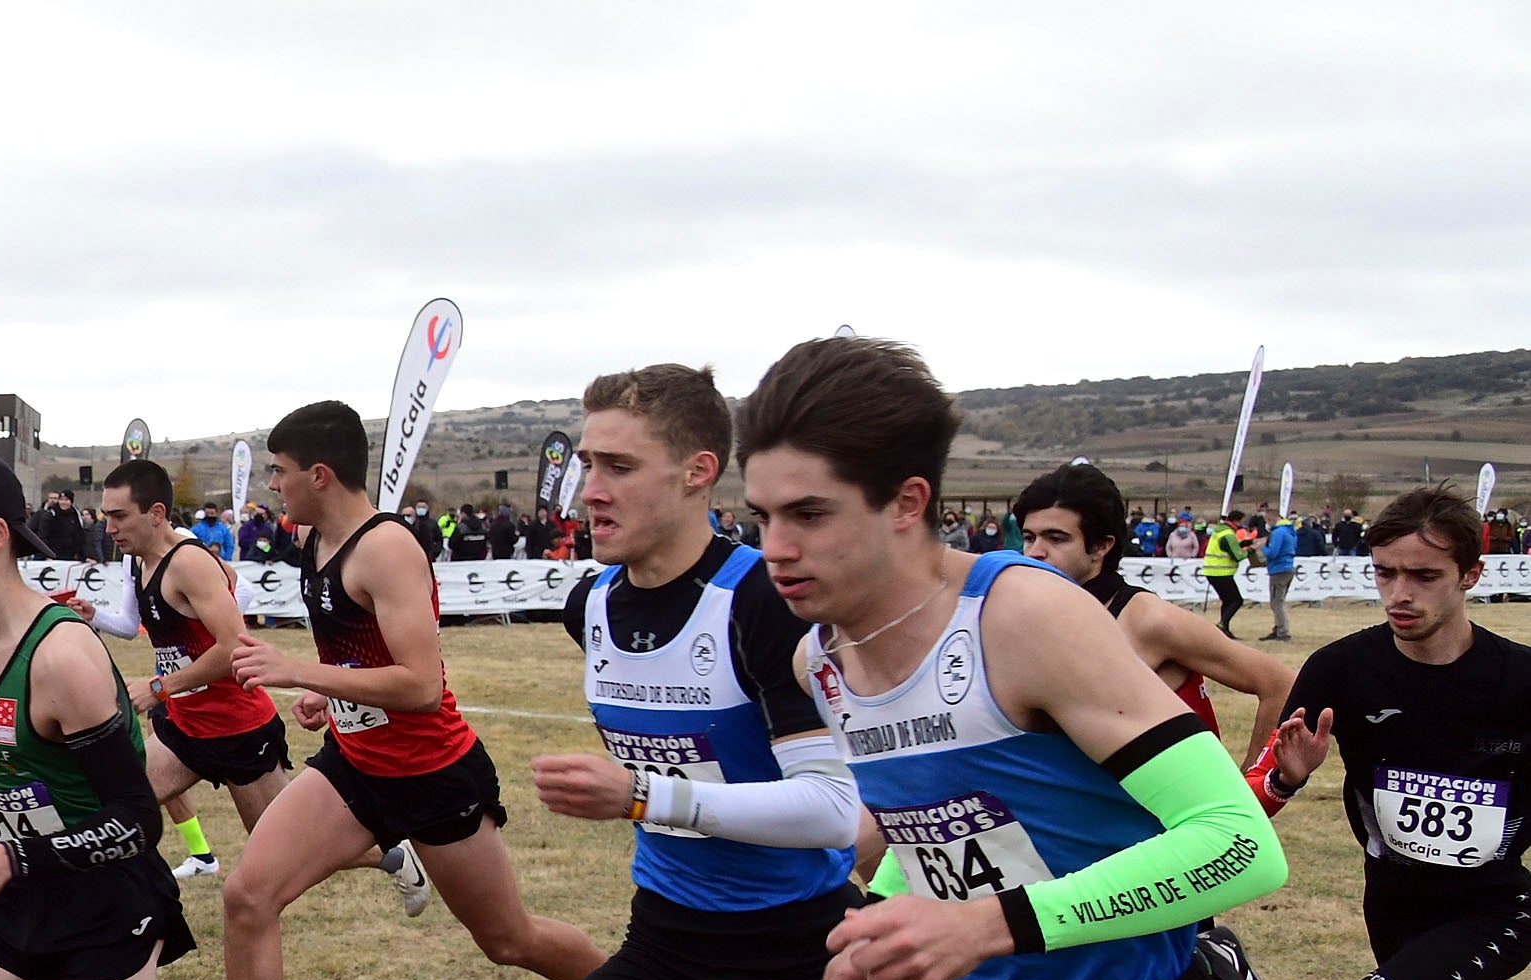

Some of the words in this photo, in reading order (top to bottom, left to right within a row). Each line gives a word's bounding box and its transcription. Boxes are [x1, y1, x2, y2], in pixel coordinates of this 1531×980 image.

[384, 379, 428, 495] iberCaja
[665, 686, 712, 705] BURGOS
[911, 712, 958, 746] BURGOS
[1387, 769, 1497, 794] DIPUTACIÓN
[1387, 779, 1495, 806] BURGOS
[879, 796, 982, 827] DIPUTACIÓN
[1396, 796, 1474, 842] 583
[886, 812, 996, 844] BURGOS
[1387, 834, 1441, 858] iberCaja
[915, 838, 1005, 901] 634
[1071, 886, 1158, 925] VILLASUR
[1155, 877, 1187, 904] DE
[1183, 833, 1260, 894] HERREROS
